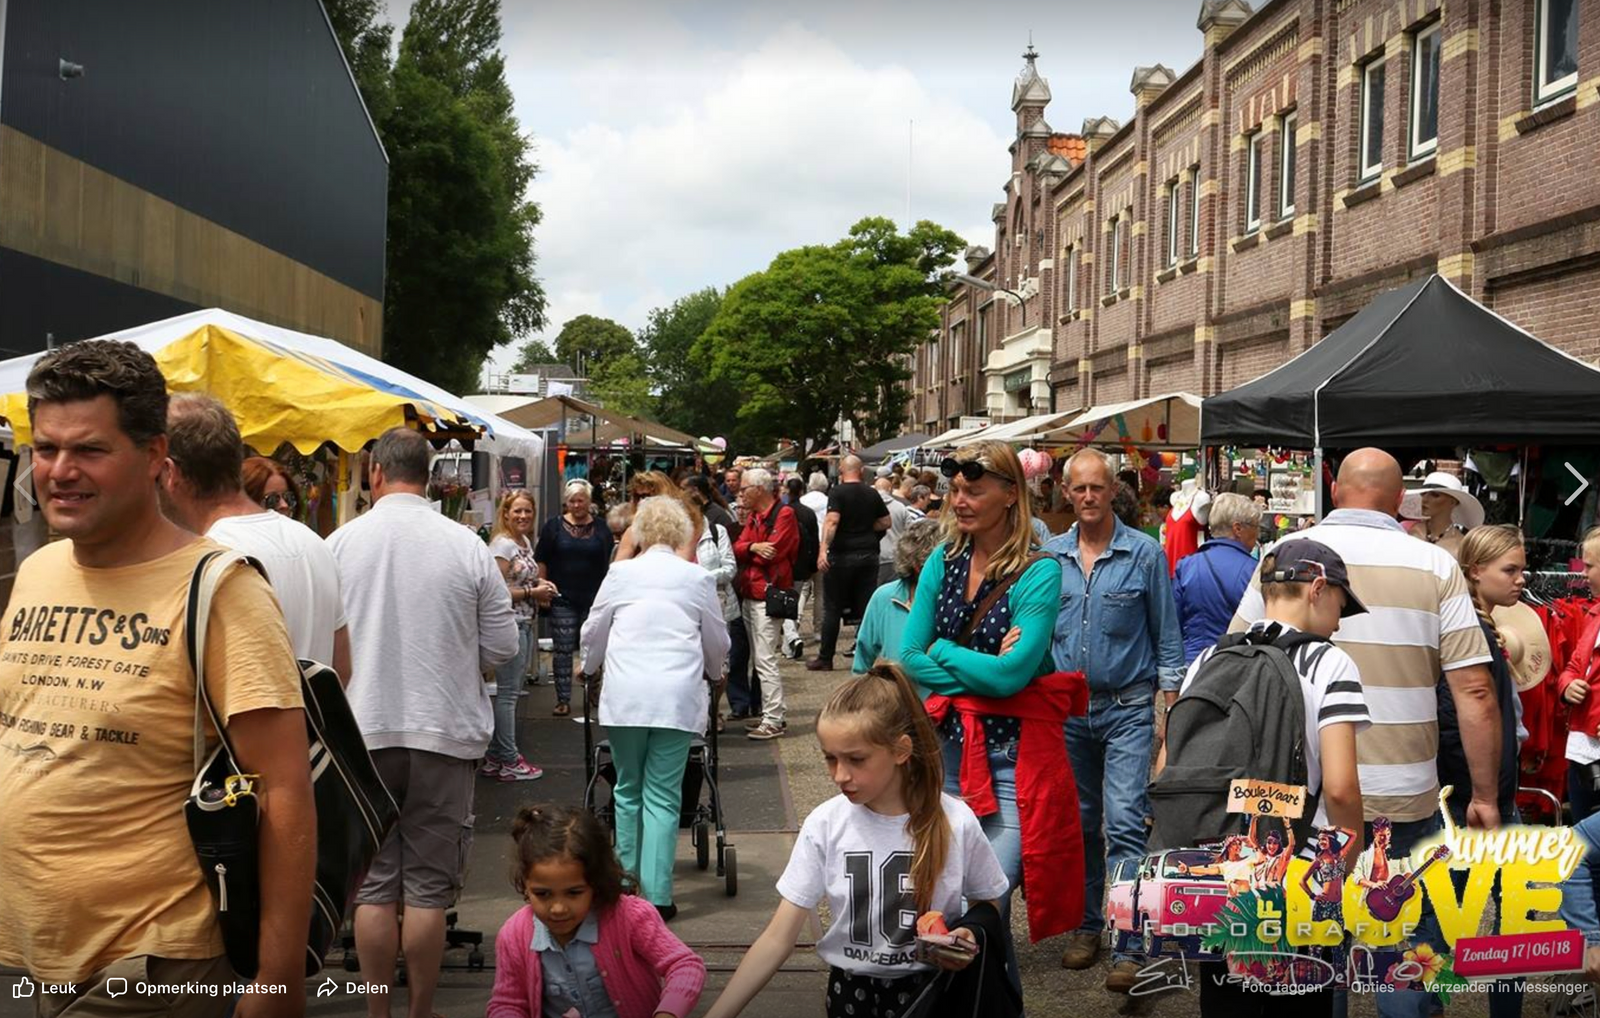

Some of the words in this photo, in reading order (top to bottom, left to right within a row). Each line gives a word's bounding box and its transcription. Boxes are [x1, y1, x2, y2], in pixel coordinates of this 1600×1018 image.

[67, 656, 112, 670] FOREST
[113, 662, 150, 678] GATE
[22, 674, 71, 688] LONDON,
[76, 678, 105, 692] N.W
[50, 722, 75, 739] GEAR
[80, 726, 89, 740] &
[95, 728, 139, 745] TACKLE
